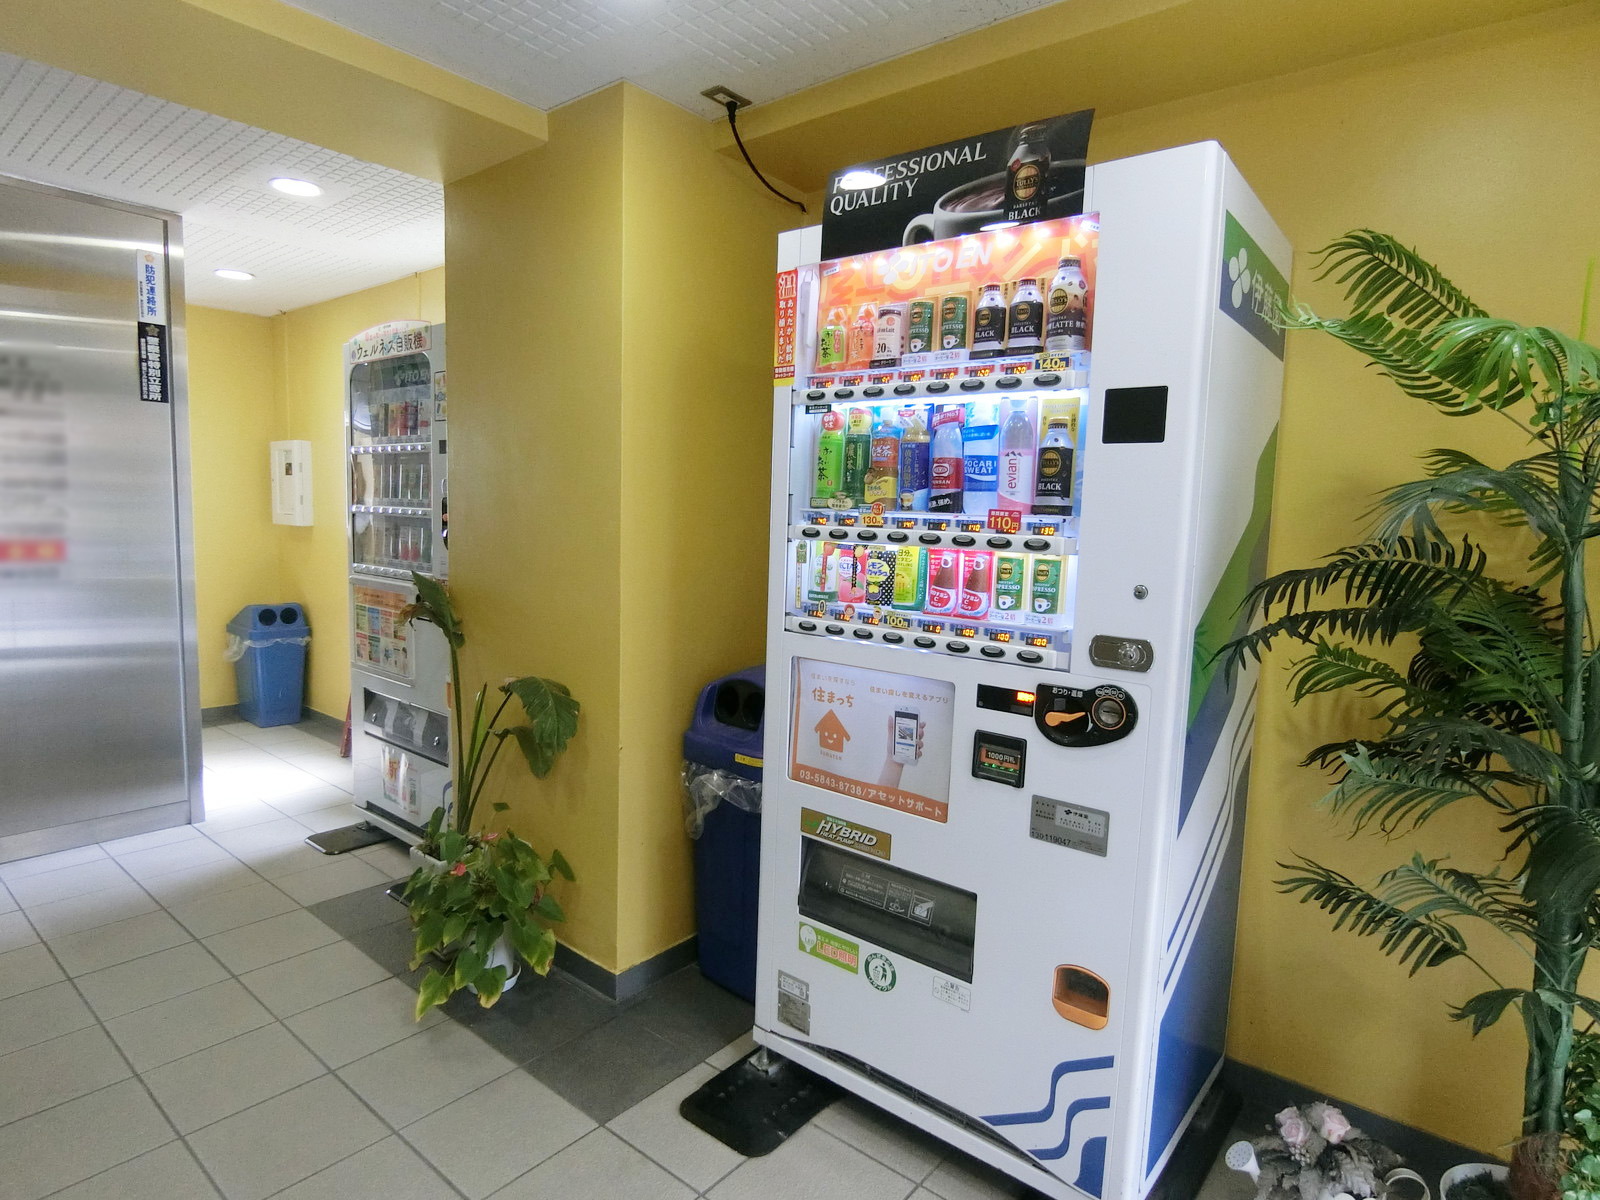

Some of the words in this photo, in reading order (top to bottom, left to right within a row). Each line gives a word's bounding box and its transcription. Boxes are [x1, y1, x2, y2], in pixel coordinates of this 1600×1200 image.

[830, 177, 918, 216] QUALITY
[1008, 206, 1041, 220] BLACK
[909, 252, 954, 277] ITO
[955, 241, 994, 270] EN
[144, 264, 157, 317] 防犯連絡所
[356, 330, 424, 361] ウェルネス自販機
[1038, 358, 1066, 369] 140円
[1007, 458, 1017, 490] evian
[1038, 483, 1062, 491] BLACK
[990, 516, 1019, 530] 110円
[1041, 527, 1055, 535] 130
[886, 616, 908, 628] 100円
[963, 629, 975, 638] 100
[997, 632, 1010, 641] 100
[1033, 638, 1048, 647] 100
[811, 686, 855, 708] 住まっち
[869, 685, 949, 704] 住まい探しを変えるアプリ
[816, 820, 878, 846] HYBRID
[816, 940, 858, 968] LED照明
